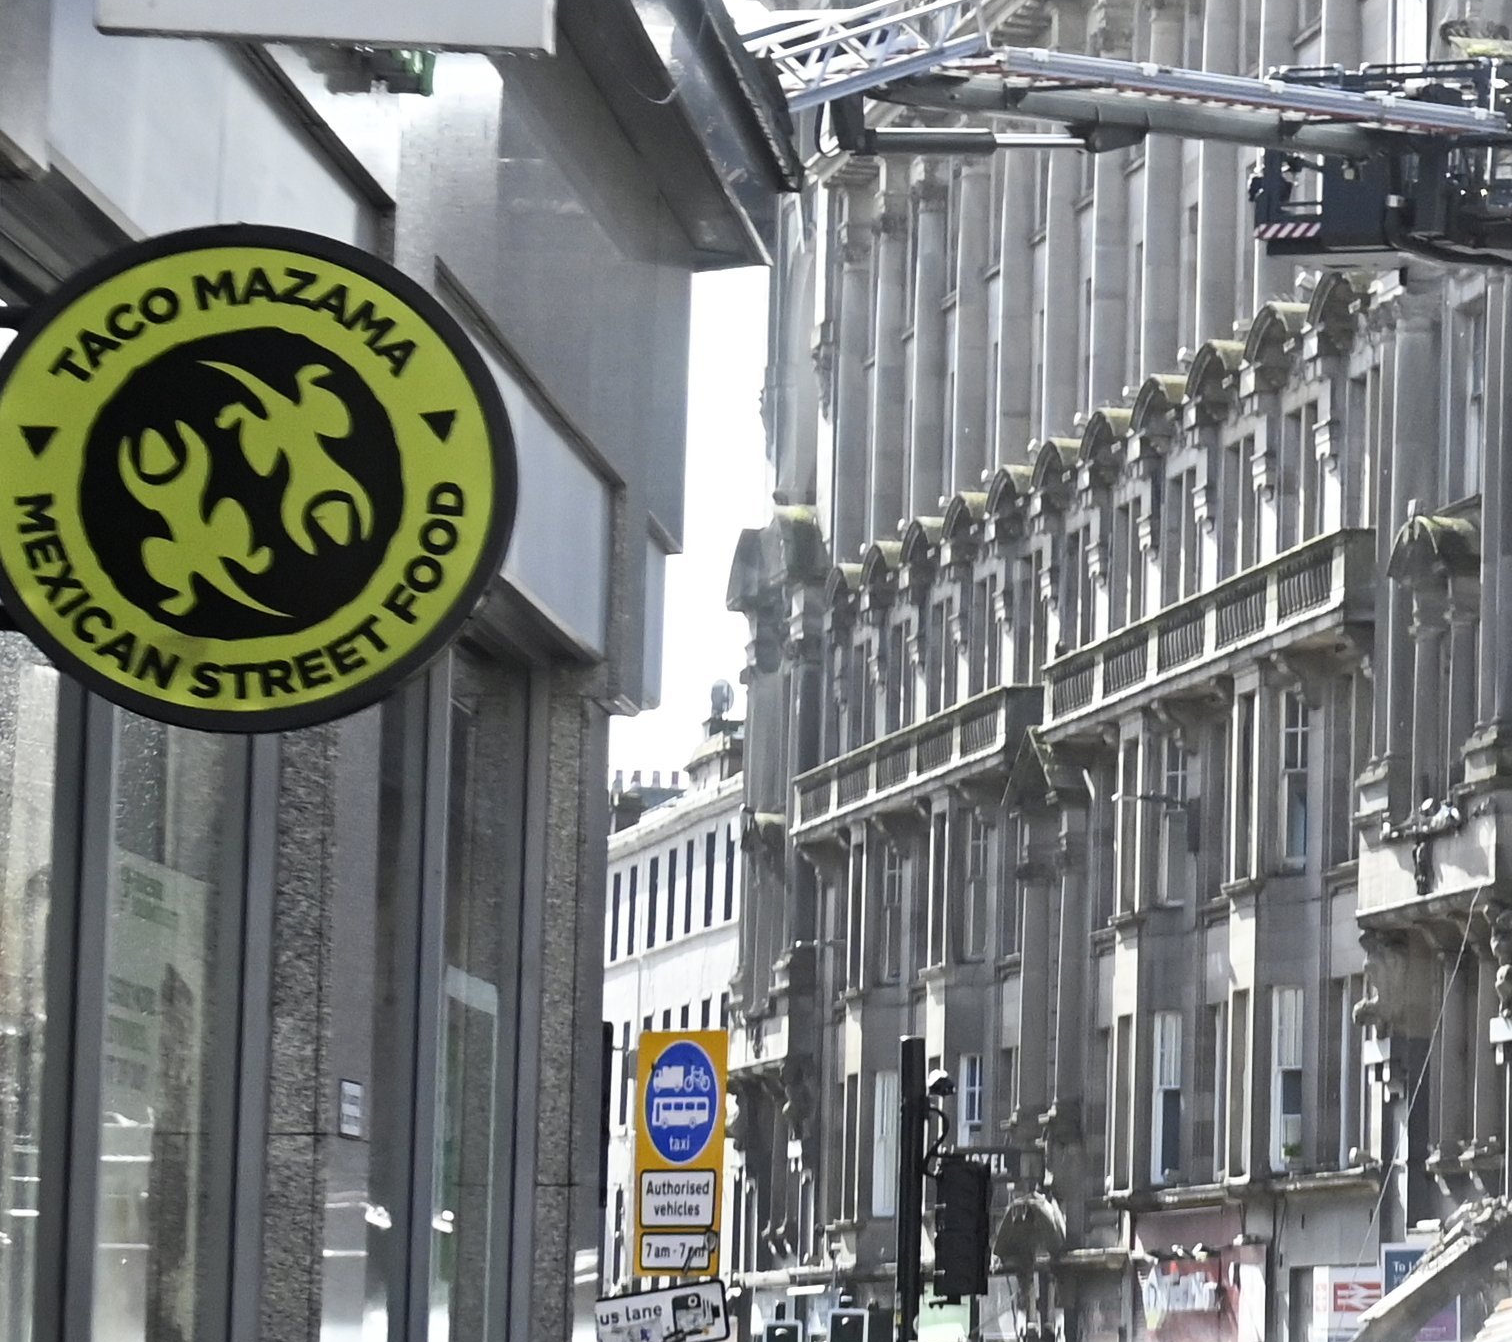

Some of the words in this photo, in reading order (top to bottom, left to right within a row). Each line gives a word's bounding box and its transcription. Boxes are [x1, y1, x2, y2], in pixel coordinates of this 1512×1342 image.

[48, 286, 181, 384] TACO
[193, 266, 419, 378] MAZAMA
[13, 492, 180, 690] MEXICAN
[188, 614, 389, 701] STREET
[382, 480, 467, 626] FOOD
[669, 1134, 691, 1151] taxi
[646, 1179, 710, 1196] Authorised
[654, 1201, 700, 1217] vehicles
[646, 1243, 653, 1258] 7
[654, 1246, 671, 1258] am
[680, 1243, 687, 1259] 7
[600, 1312, 620, 1326] us
[625, 1305, 662, 1322] lane
